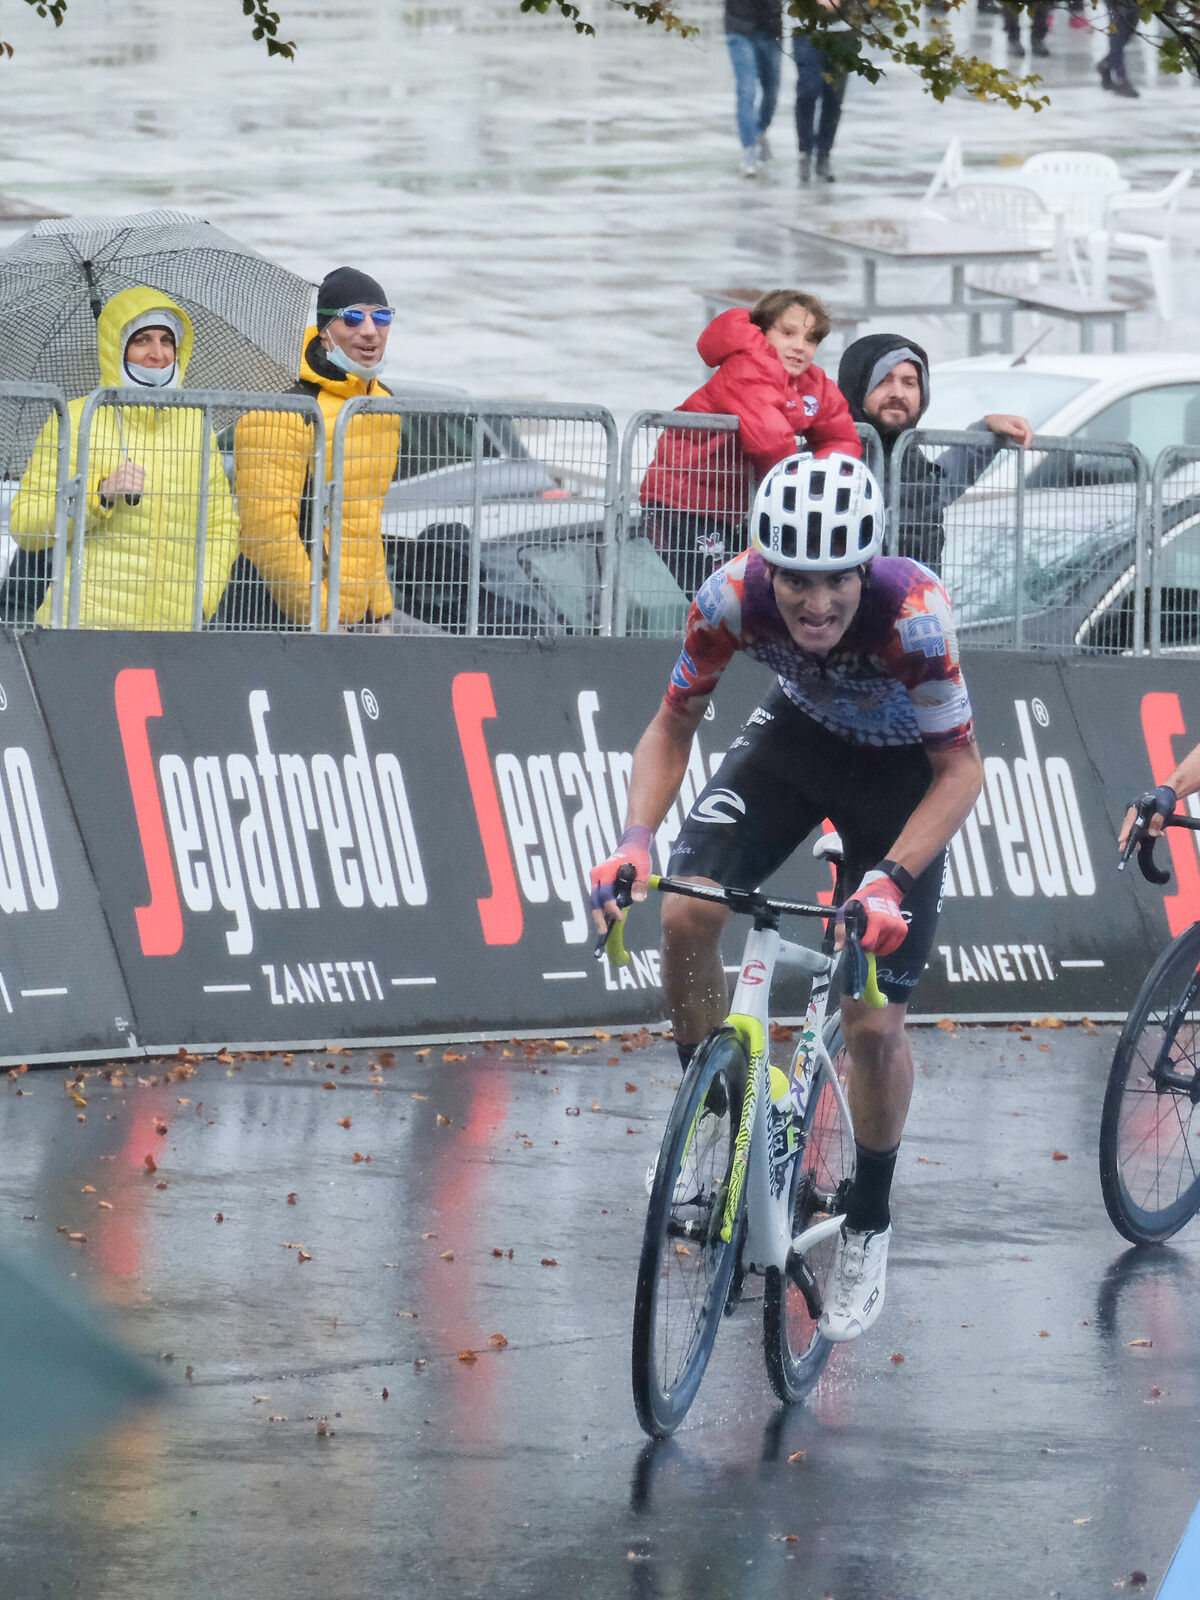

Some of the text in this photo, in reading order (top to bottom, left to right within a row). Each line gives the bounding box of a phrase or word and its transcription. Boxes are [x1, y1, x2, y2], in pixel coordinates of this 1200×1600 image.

[114, 668, 429, 956] Segafredo
[452, 671, 727, 945] Segafr
[261, 960, 385, 1005] ZANETTI
[598, 949, 663, 991] ZANE
[938, 944, 1055, 982] ZANETTI
